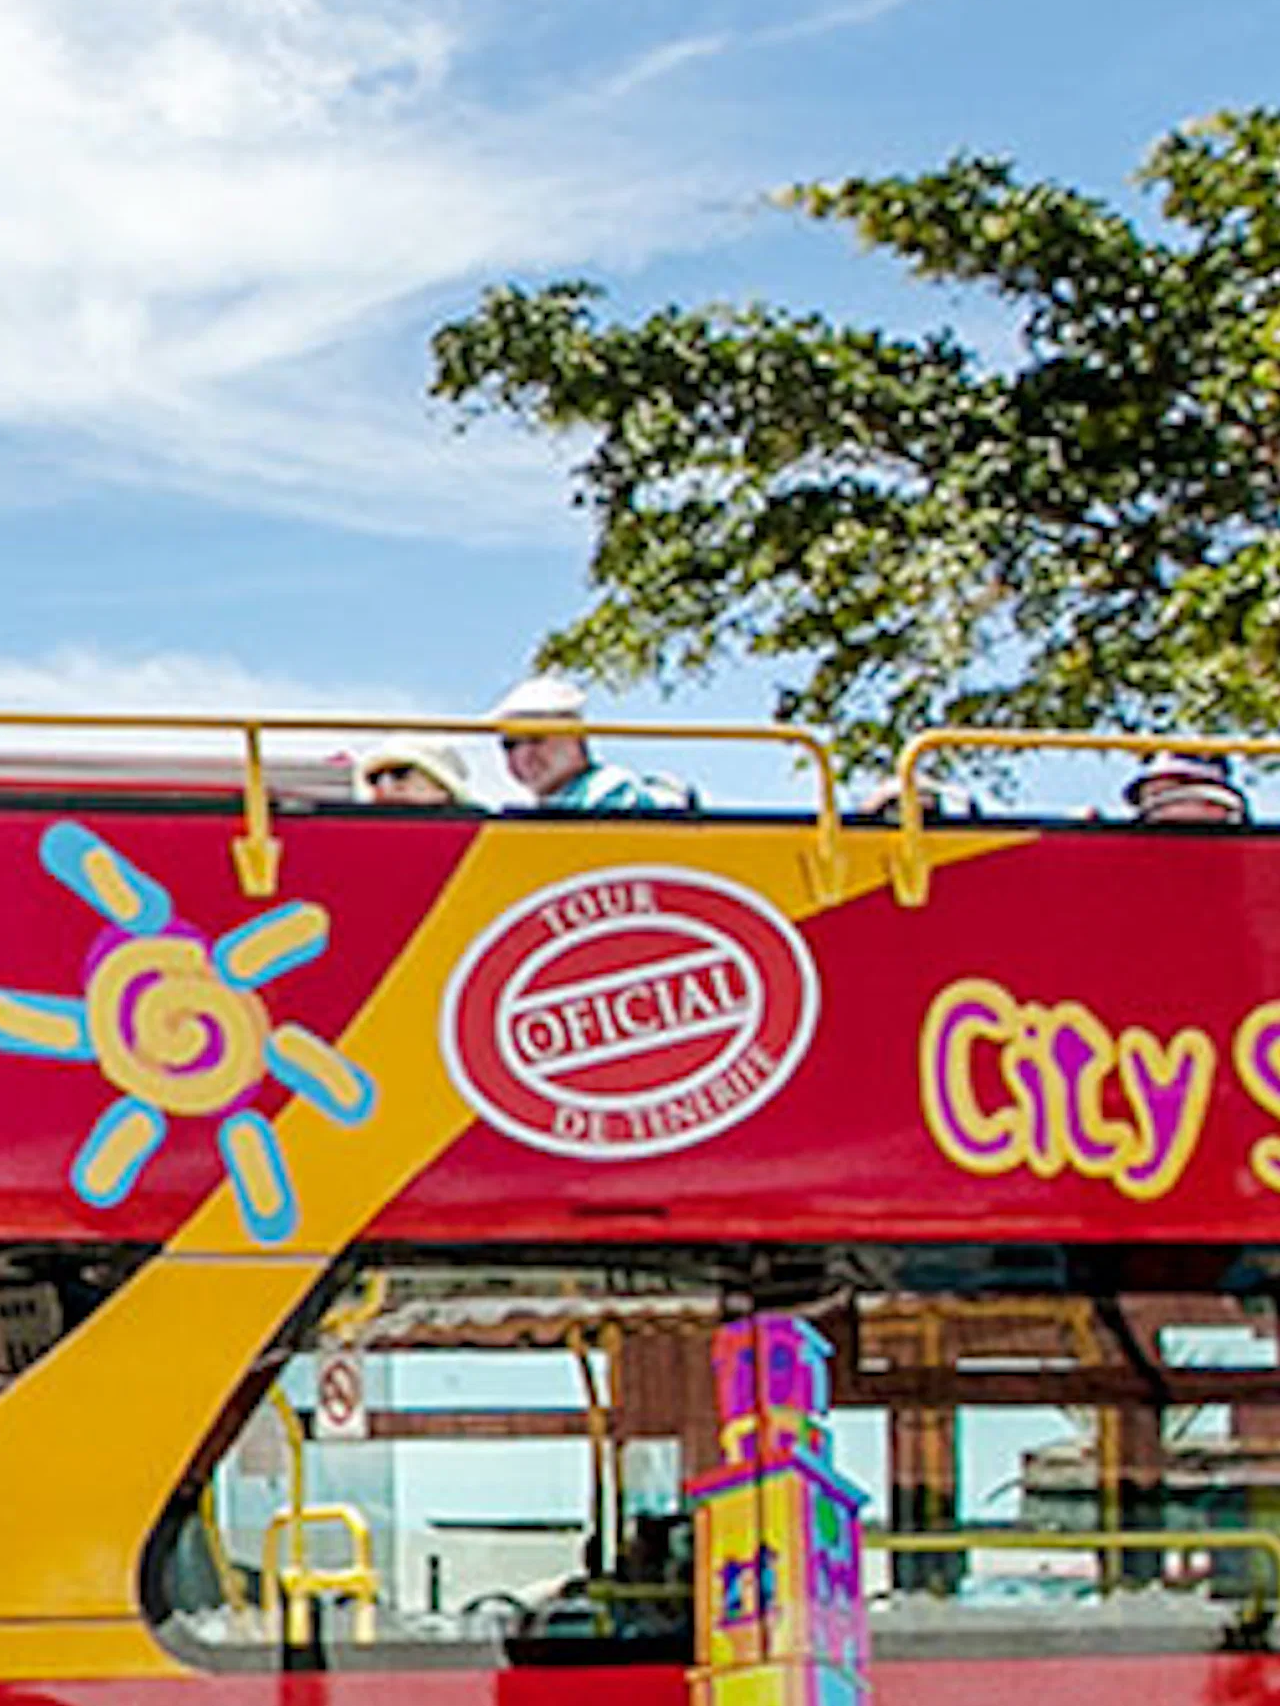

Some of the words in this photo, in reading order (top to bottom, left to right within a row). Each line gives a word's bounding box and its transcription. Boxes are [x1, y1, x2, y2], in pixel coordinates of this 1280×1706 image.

[540, 881, 658, 936] TOUR
[514, 965, 745, 1061] OFICIAL
[920, 977, 1216, 1200] City
